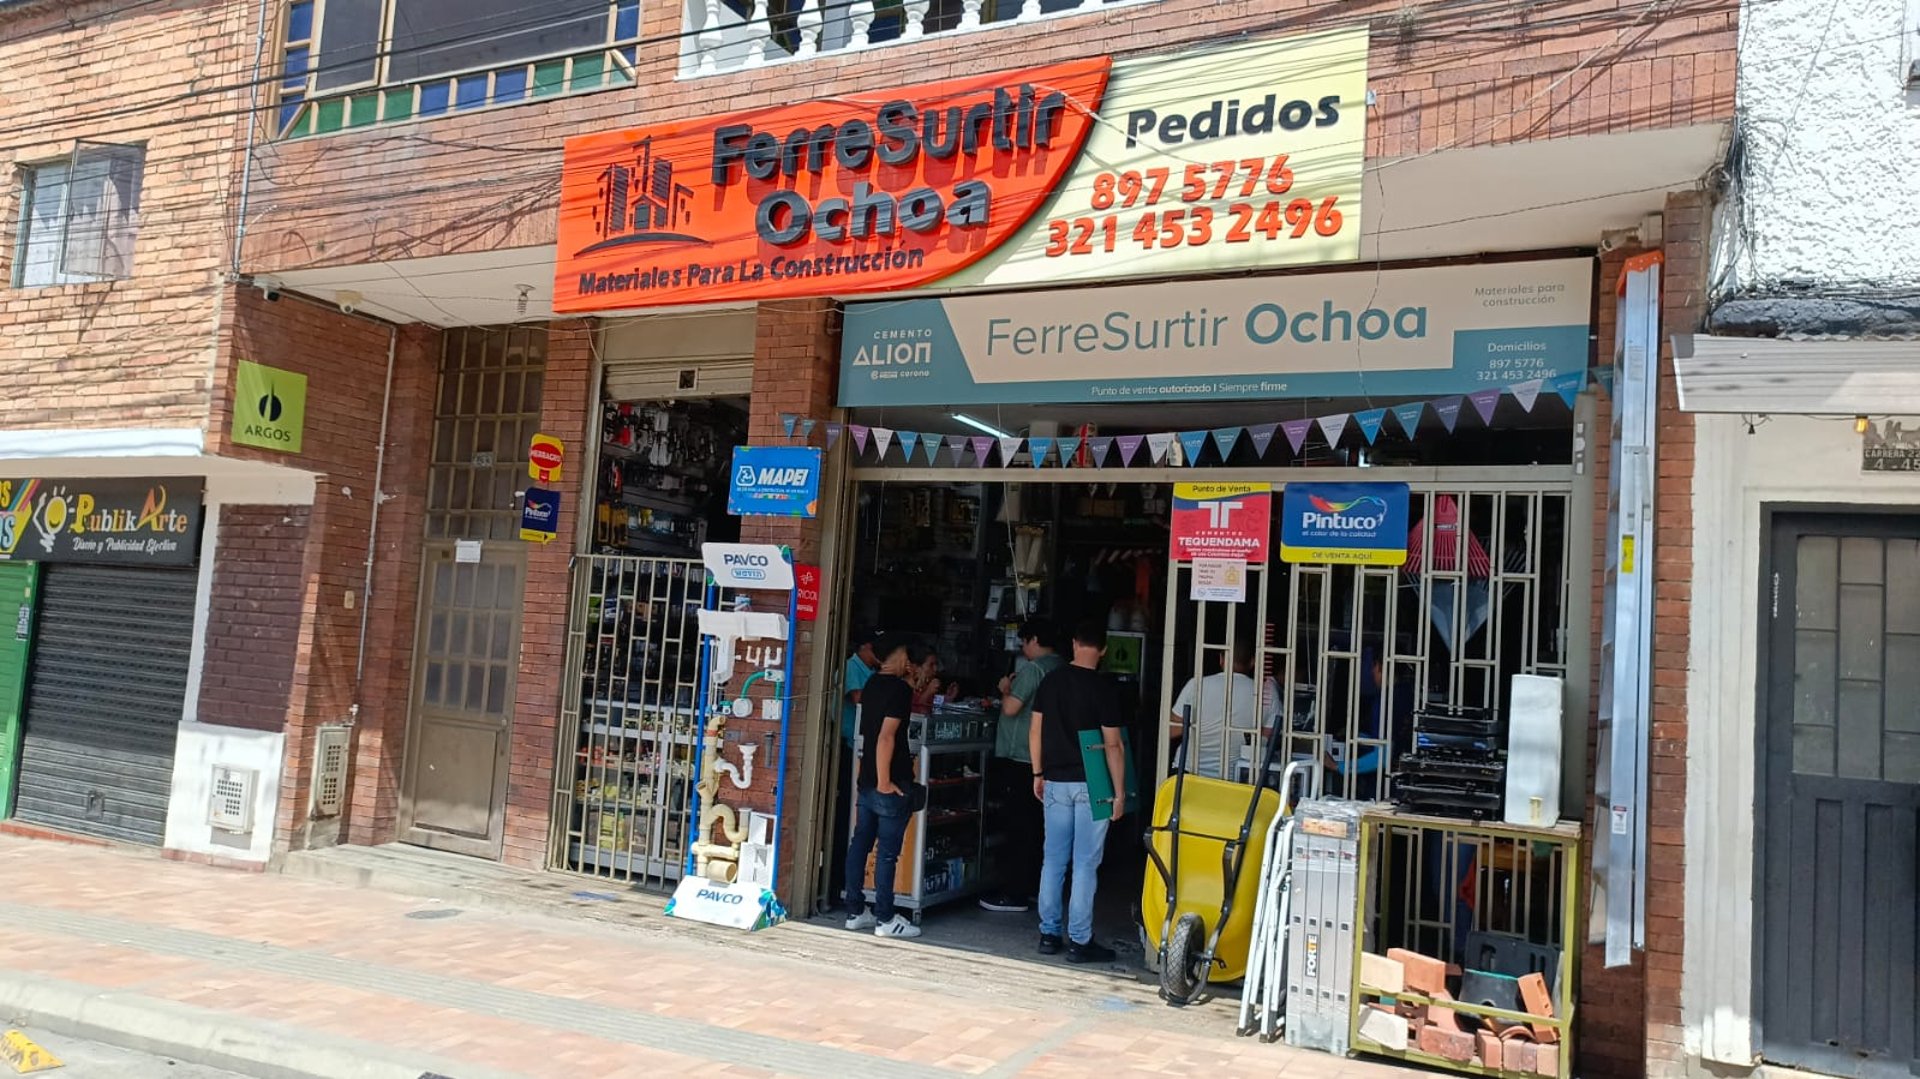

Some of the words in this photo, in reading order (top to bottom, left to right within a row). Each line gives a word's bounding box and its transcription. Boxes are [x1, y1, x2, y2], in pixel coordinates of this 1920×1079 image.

[1126, 94, 1340, 148] Pedidos
[711, 83, 1065, 185] FerreSurtir
[1090, 167, 1169, 210] 897
[1182, 154, 1294, 202] 5776
[755, 179, 992, 245] Ochoa
[1045, 215, 1117, 257] 321
[1132, 206, 1214, 249] 453
[1225, 196, 1343, 243] 2496
[578, 267, 681, 295] Materiales
[687, 263, 733, 286] Para
[740, 263, 763, 282] La
[770, 241, 923, 280] Construcción
[1474, 284, 1533, 297] Materiales
[1537, 283, 1565, 294] para
[1482, 295, 1555, 307] construcción
[873, 329, 932, 339] CEMENTO
[986, 308, 1228, 355] FerreSurtir
[1245, 300, 1427, 345] Ochoa
[1488, 340, 1547, 352] Domicilios
[1489, 359, 1510, 369] 897
[1514, 358, 1544, 368] 5776
[1476, 371, 1497, 380] 321
[1501, 370, 1524, 380] 453
[1527, 369, 1557, 379] 2496
[1091, 386, 1117, 397] Punto
[1119, 386, 1130, 395] de
[1132, 387, 1157, 395] venta
[1159, 384, 1211, 394] autorizado
[1219, 382, 1258, 394] Siempre
[1260, 381, 1287, 392] firme
[244, 424, 291, 442] ARGOS
[1865, 449, 1904, 458] CARRERA
[1874, 458, 1884, 469] 4
[757, 468, 809, 487] MAPEI
[0, 480, 12, 508] S
[1192, 485, 1215, 493] Punto
[1218, 485, 1228, 493] de
[1229, 485, 1251, 493] Venta
[1302, 512, 1376, 529] Pintuco
[1178, 536, 1260, 547] TEQUENDAMA
[724, 553, 768, 566] PAVCO
[1312, 551, 1322, 560] DE
[1325, 551, 1350, 560] VENTA
[696, 889, 743, 904] PAVCO
[1306, 935, 1317, 977] FORTE
